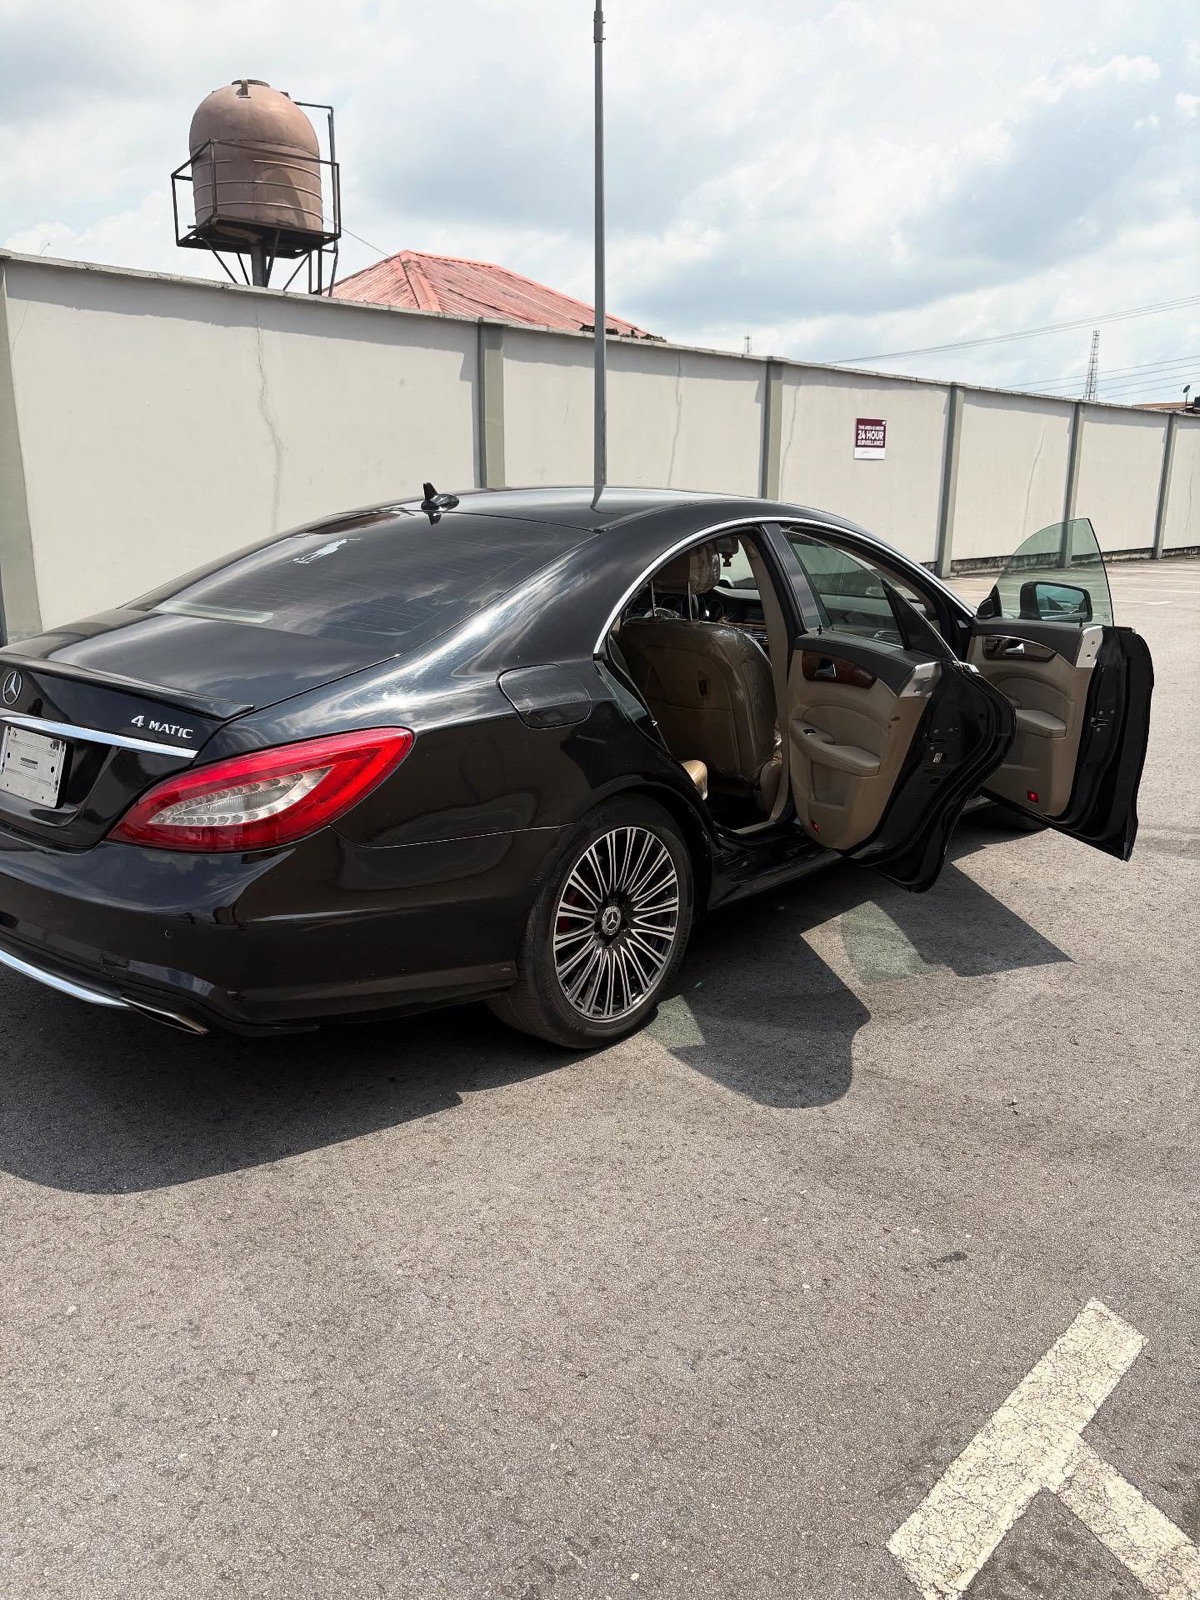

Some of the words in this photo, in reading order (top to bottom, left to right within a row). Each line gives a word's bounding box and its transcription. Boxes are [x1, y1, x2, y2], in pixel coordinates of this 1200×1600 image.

[858, 430, 866, 440] 24
[866, 430, 884, 440] HOUR
[131, 715, 145, 728] 4
[148, 720, 194, 739] MATIC
